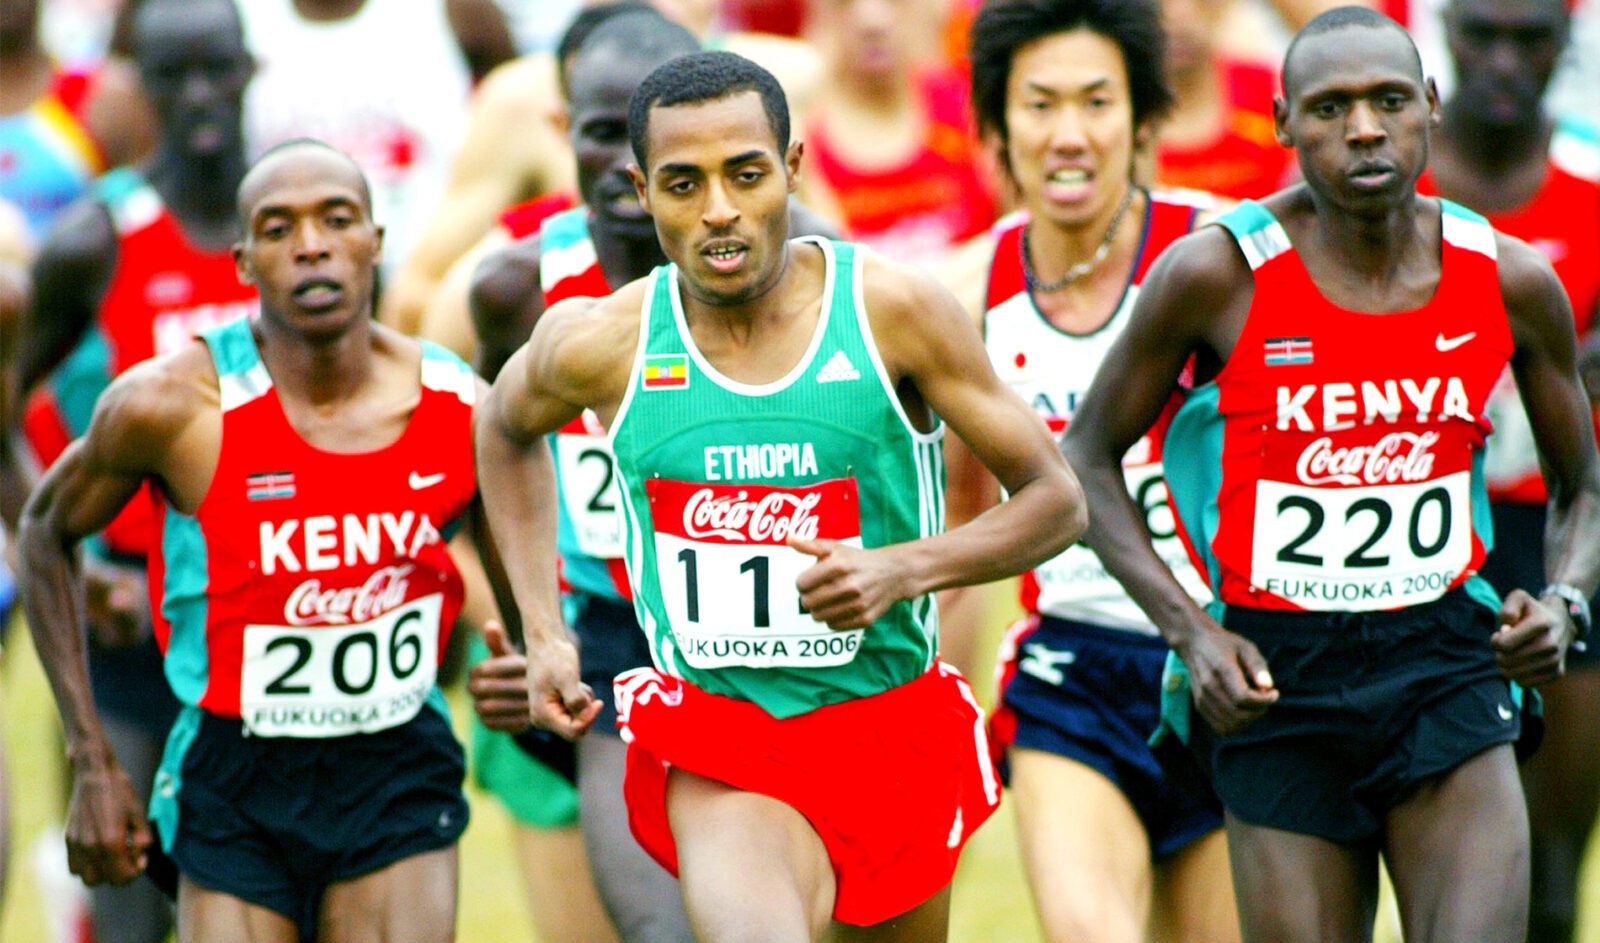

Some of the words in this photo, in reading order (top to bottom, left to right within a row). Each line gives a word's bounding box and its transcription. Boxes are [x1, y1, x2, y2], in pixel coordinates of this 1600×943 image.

[1276, 376, 1474, 432] KENYA
[704, 442, 818, 480] ETHIOPIA
[260, 510, 440, 575] KENYA
[1276, 486, 1452, 568] 220
[678, 547, 812, 628] 11
[264, 610, 422, 696] 206
[798, 634, 858, 657] 2006
[253, 705, 380, 728] FUKUOKA
